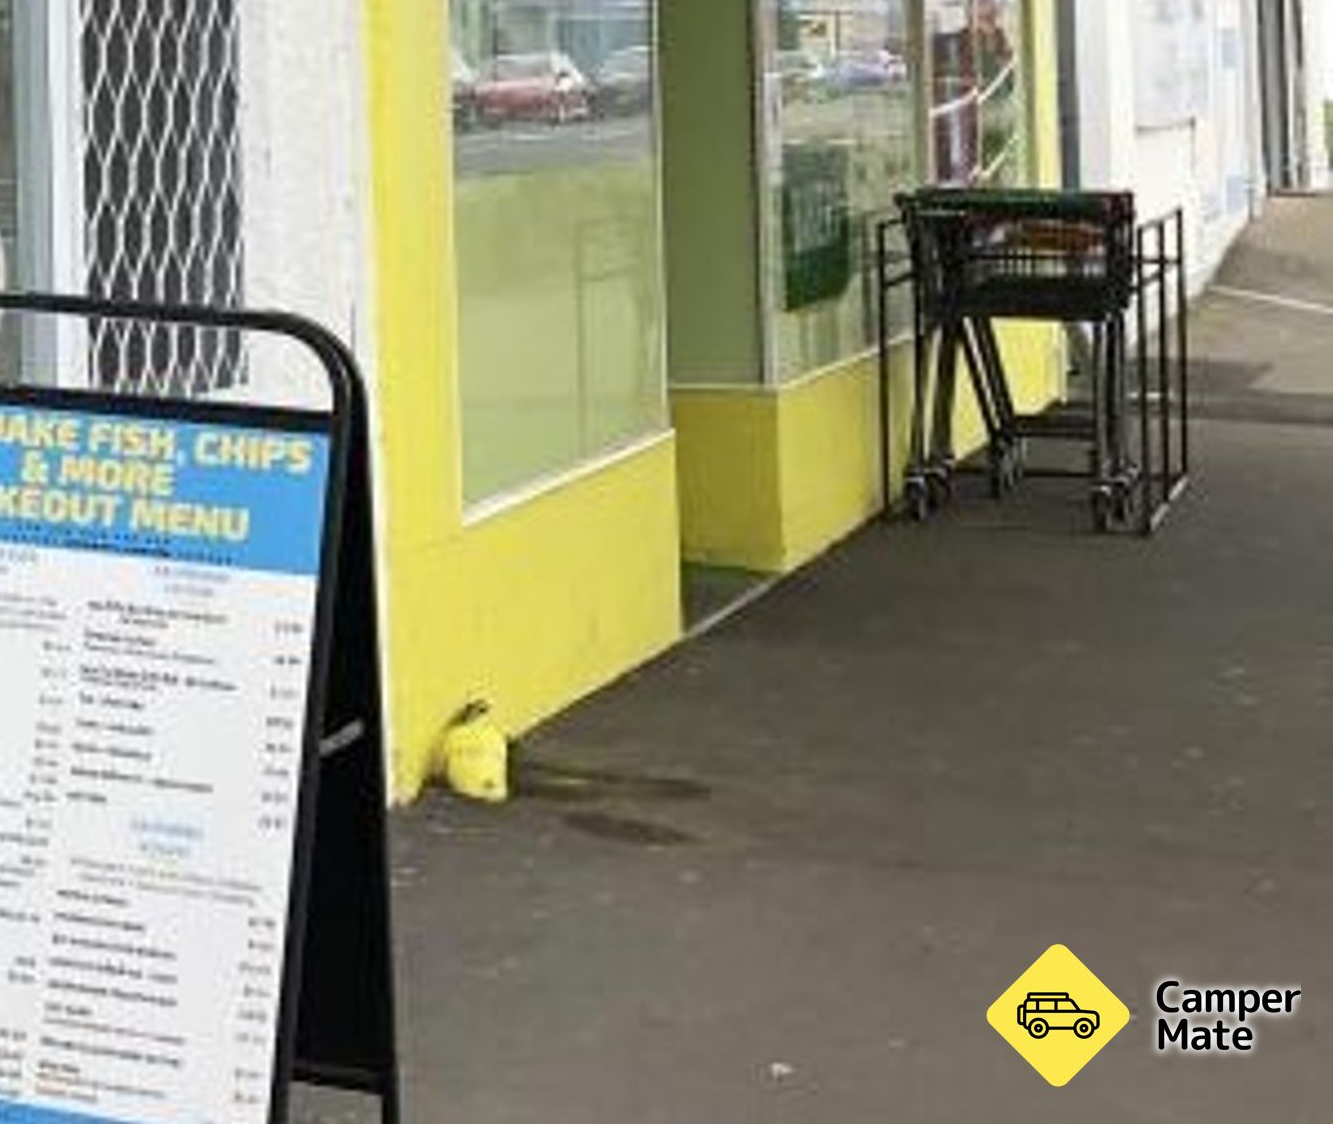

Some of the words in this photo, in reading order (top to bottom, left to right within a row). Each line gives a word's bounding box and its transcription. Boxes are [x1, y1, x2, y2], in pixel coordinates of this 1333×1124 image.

[89, 422, 187, 468] FISH,
[194, 432, 313, 475] CHIPS
[21, 450, 49, 484] &
[60, 454, 175, 497] MORE
[131, 498, 251, 542] MENU
